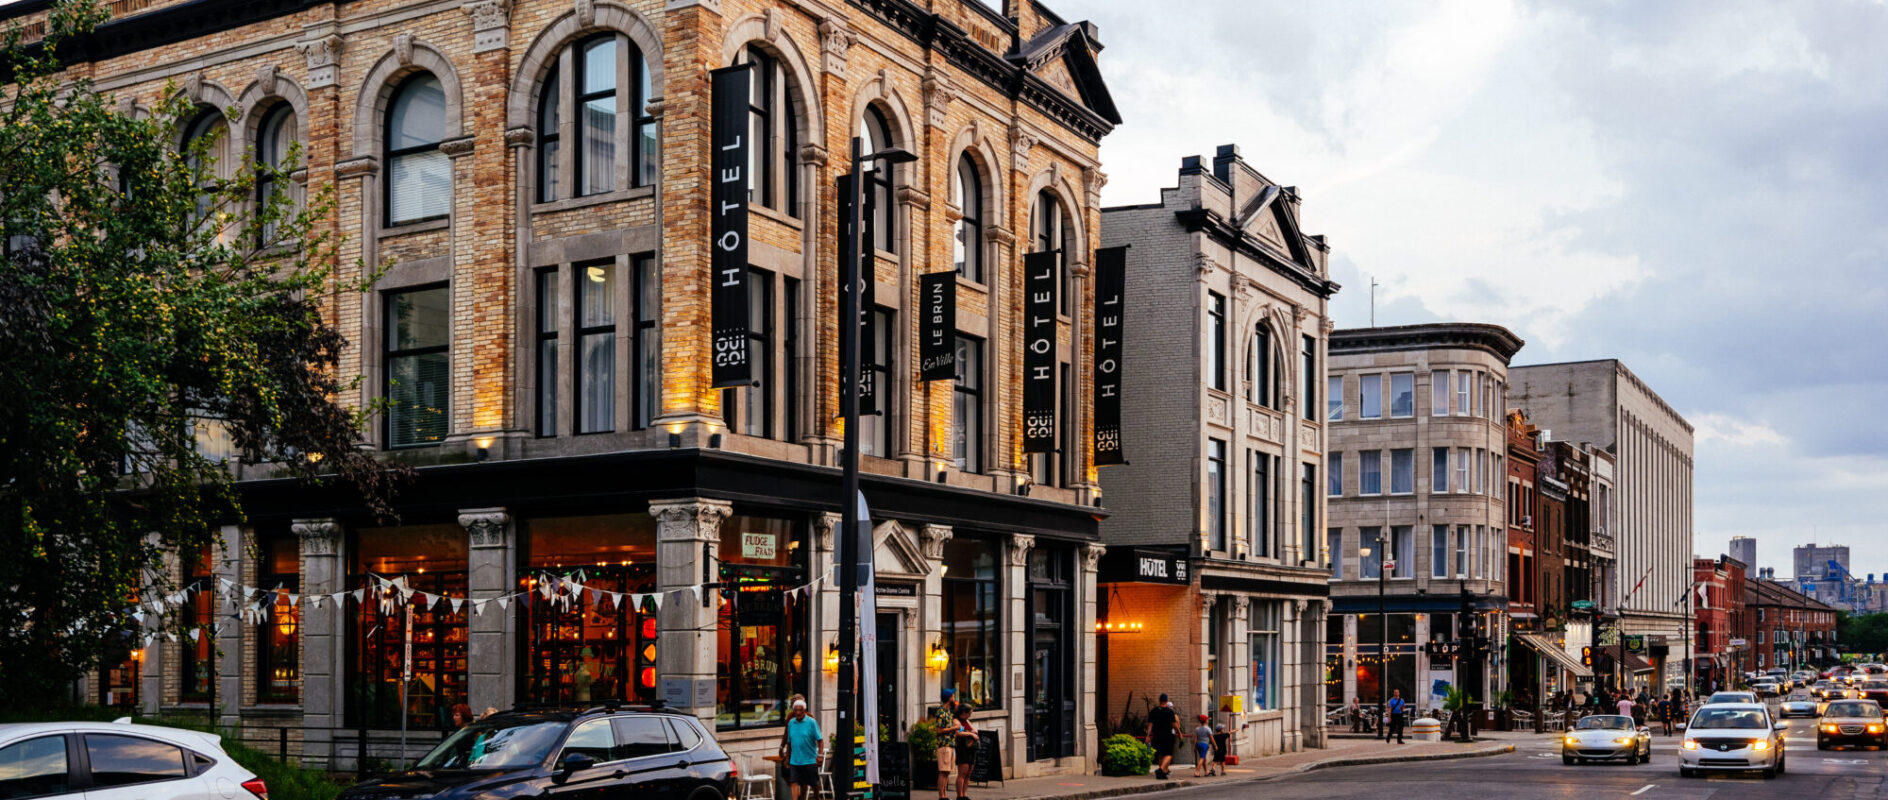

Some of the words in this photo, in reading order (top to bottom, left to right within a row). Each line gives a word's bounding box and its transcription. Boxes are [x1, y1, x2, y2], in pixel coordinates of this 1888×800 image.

[717, 134, 740, 287] HÔTEL
[933, 283, 943, 324] BRUN
[1031, 267, 1051, 380] HÔTEL
[933, 328, 943, 346] LE
[1099, 294, 1118, 398] HÔTEL
[922, 357, 936, 371] En
[935, 353, 954, 367] Ville
[744, 535, 769, 547] FUDGE
[1139, 557, 1168, 578] HÔTEL
[740, 661, 752, 677] LE
[753, 659, 778, 674] BRUN
